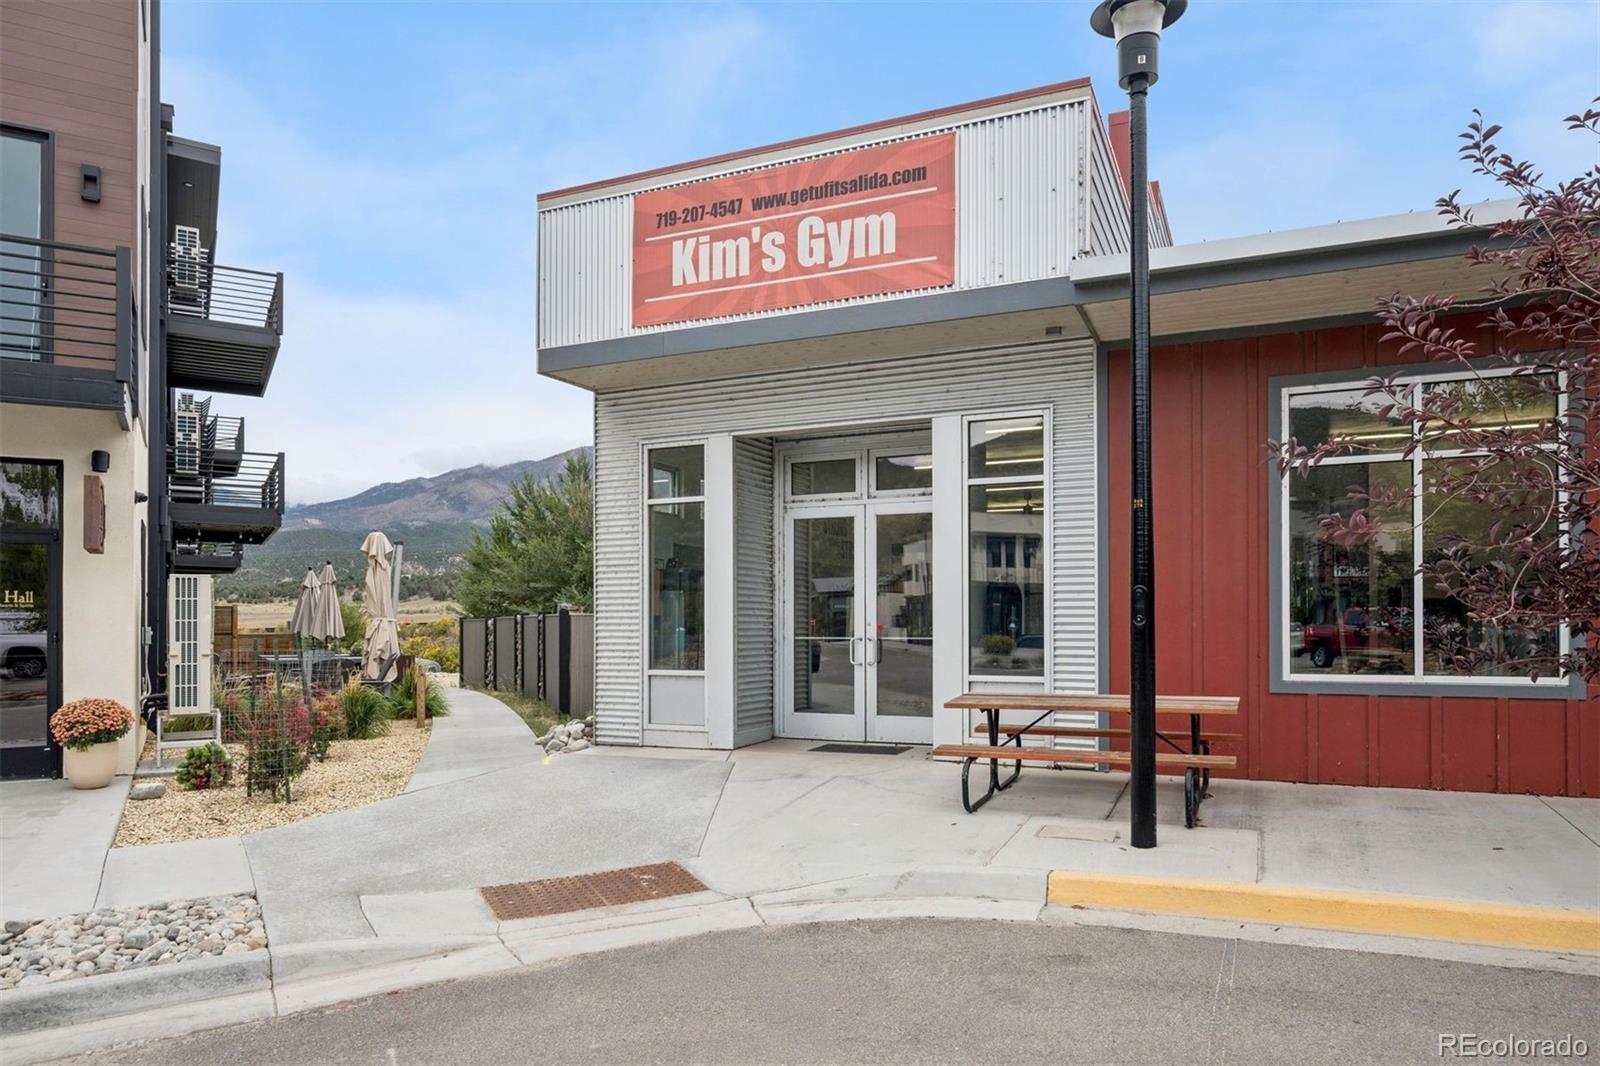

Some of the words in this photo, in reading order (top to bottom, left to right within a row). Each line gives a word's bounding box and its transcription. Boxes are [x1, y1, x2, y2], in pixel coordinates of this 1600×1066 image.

[656, 199, 743, 229] 719-207-4547
[751, 166, 927, 212] www.getufitsalida.com
[672, 226, 786, 287] Kim's
[797, 211, 897, 269] Gym
[4, 590, 34, 603] Hall
